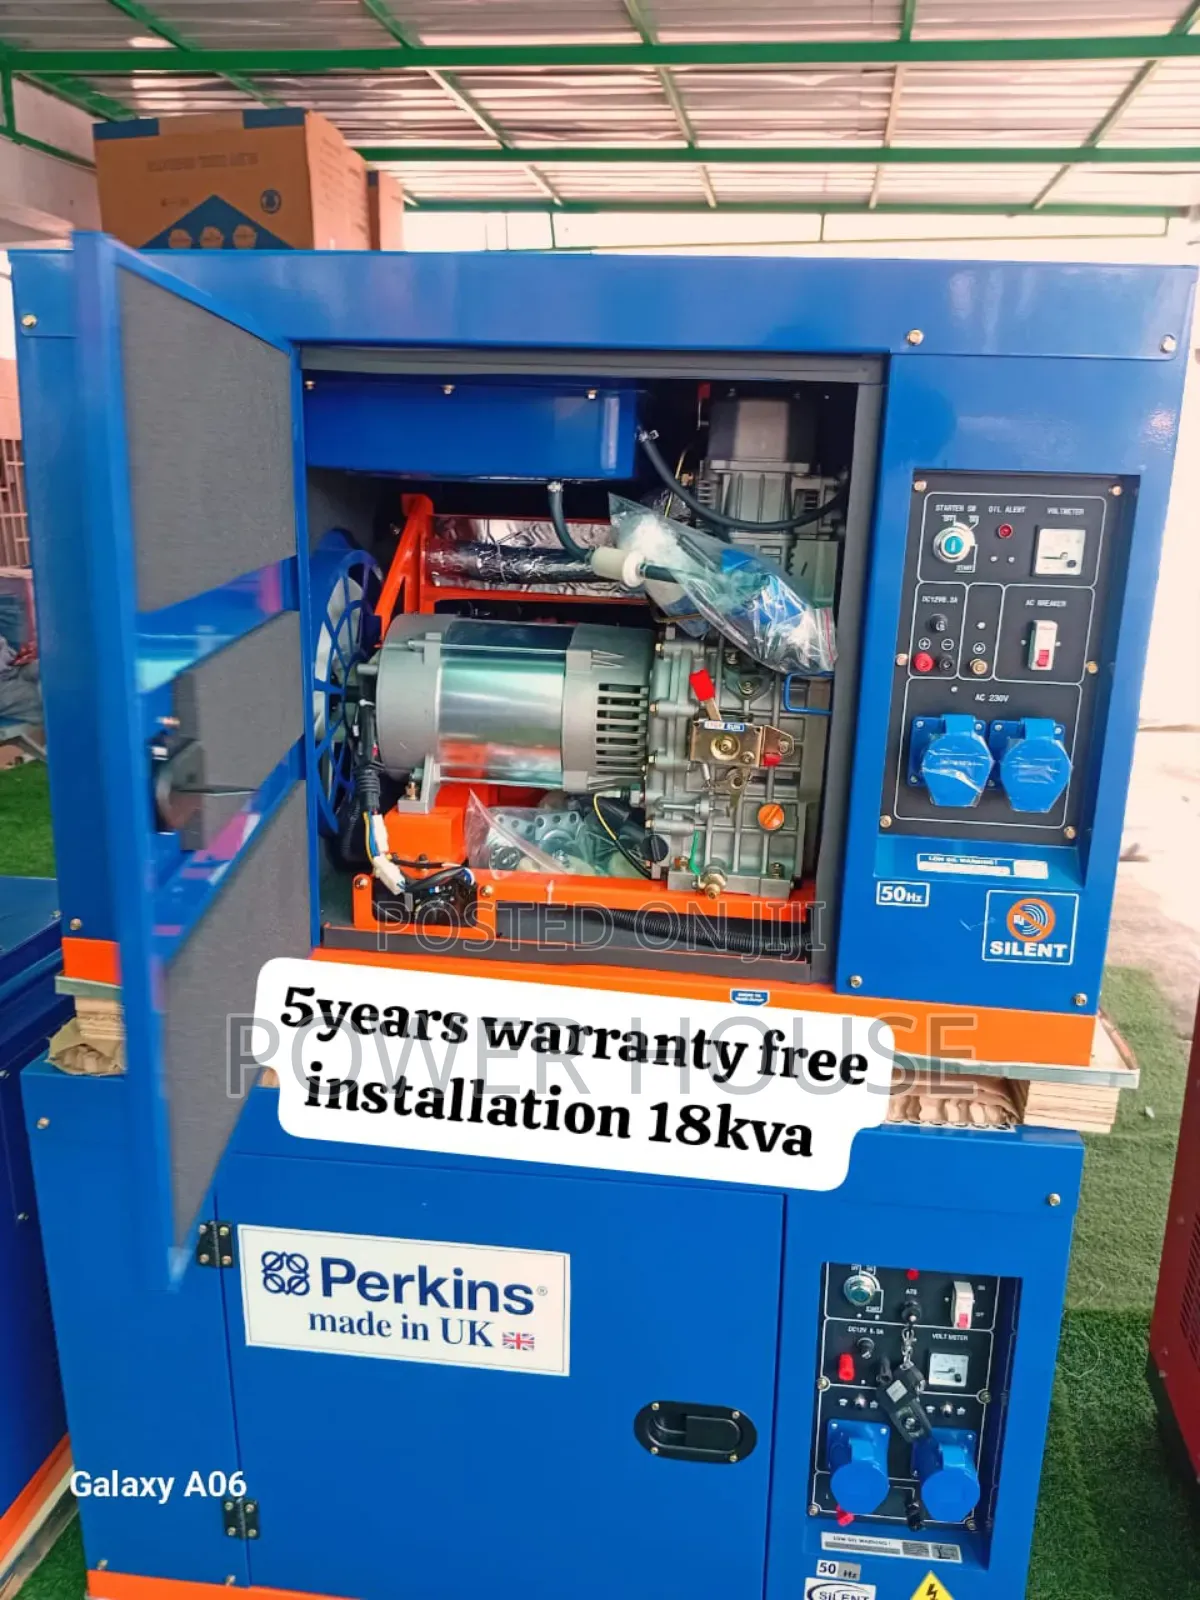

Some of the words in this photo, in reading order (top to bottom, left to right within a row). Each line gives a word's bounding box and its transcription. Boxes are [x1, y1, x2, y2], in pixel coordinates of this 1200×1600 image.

[1047, 507, 1085, 515] VOLTMETER
[988, 694, 1009, 702] 230V
[989, 941, 1068, 958] SILENT
[320, 1256, 535, 1316] Perkins
[308, 1310, 392, 1337] made
[401, 1314, 430, 1342] in
[439, 1317, 494, 1348] UK
[819, 1562, 837, 1574] 50
[843, 1570, 857, 1579] Hz
